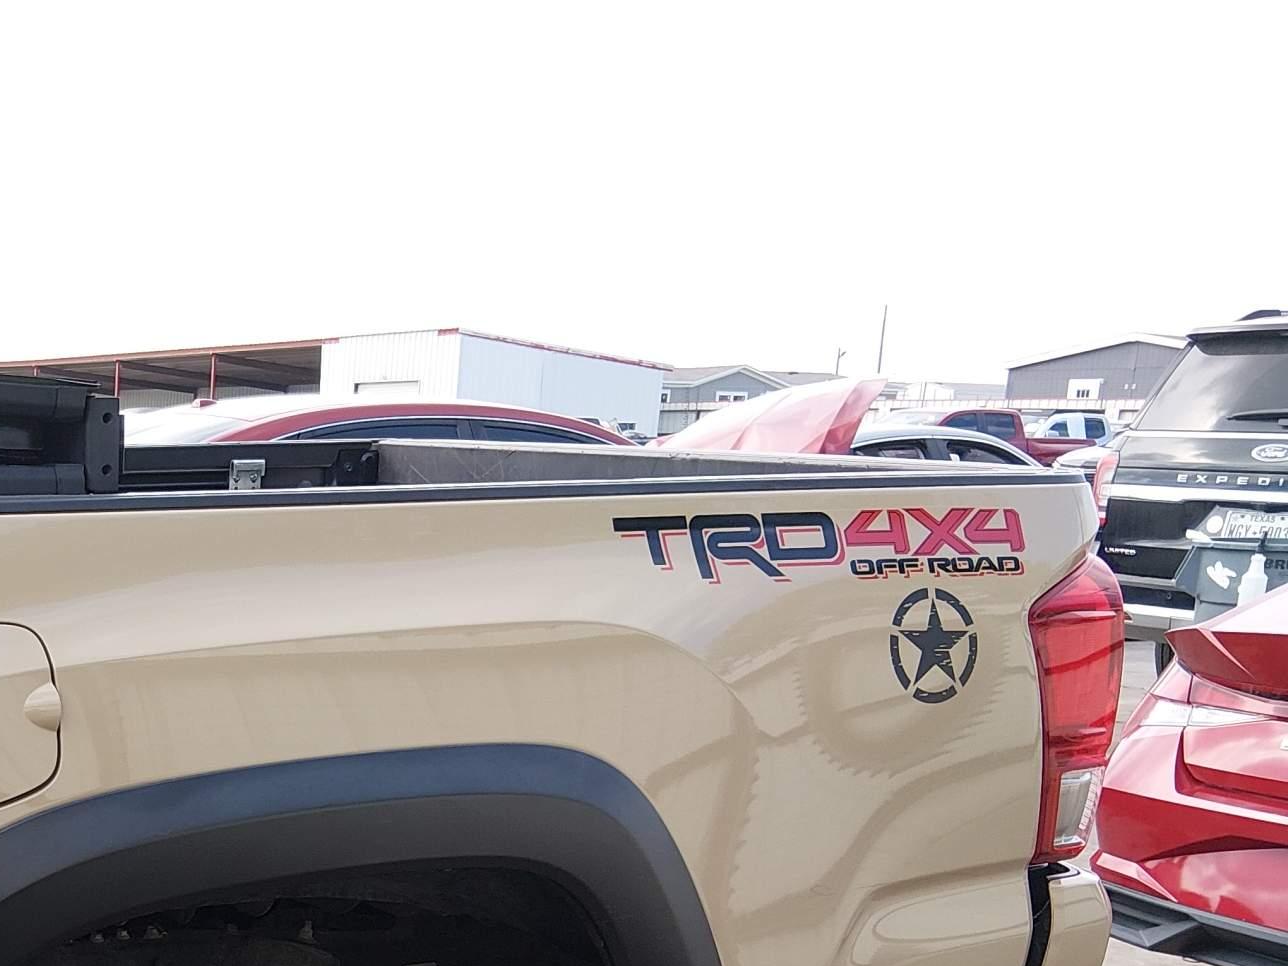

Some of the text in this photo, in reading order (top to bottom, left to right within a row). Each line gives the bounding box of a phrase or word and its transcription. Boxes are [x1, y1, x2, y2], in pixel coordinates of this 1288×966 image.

[1258, 446, 1287, 458] Ford
[1250, 514, 1276, 523] TEXAS
[612, 508, 1026, 584] TRD 4X4
[850, 555, 1025, 578] OFF ROAD
[1264, 558, 1288, 570] BR
